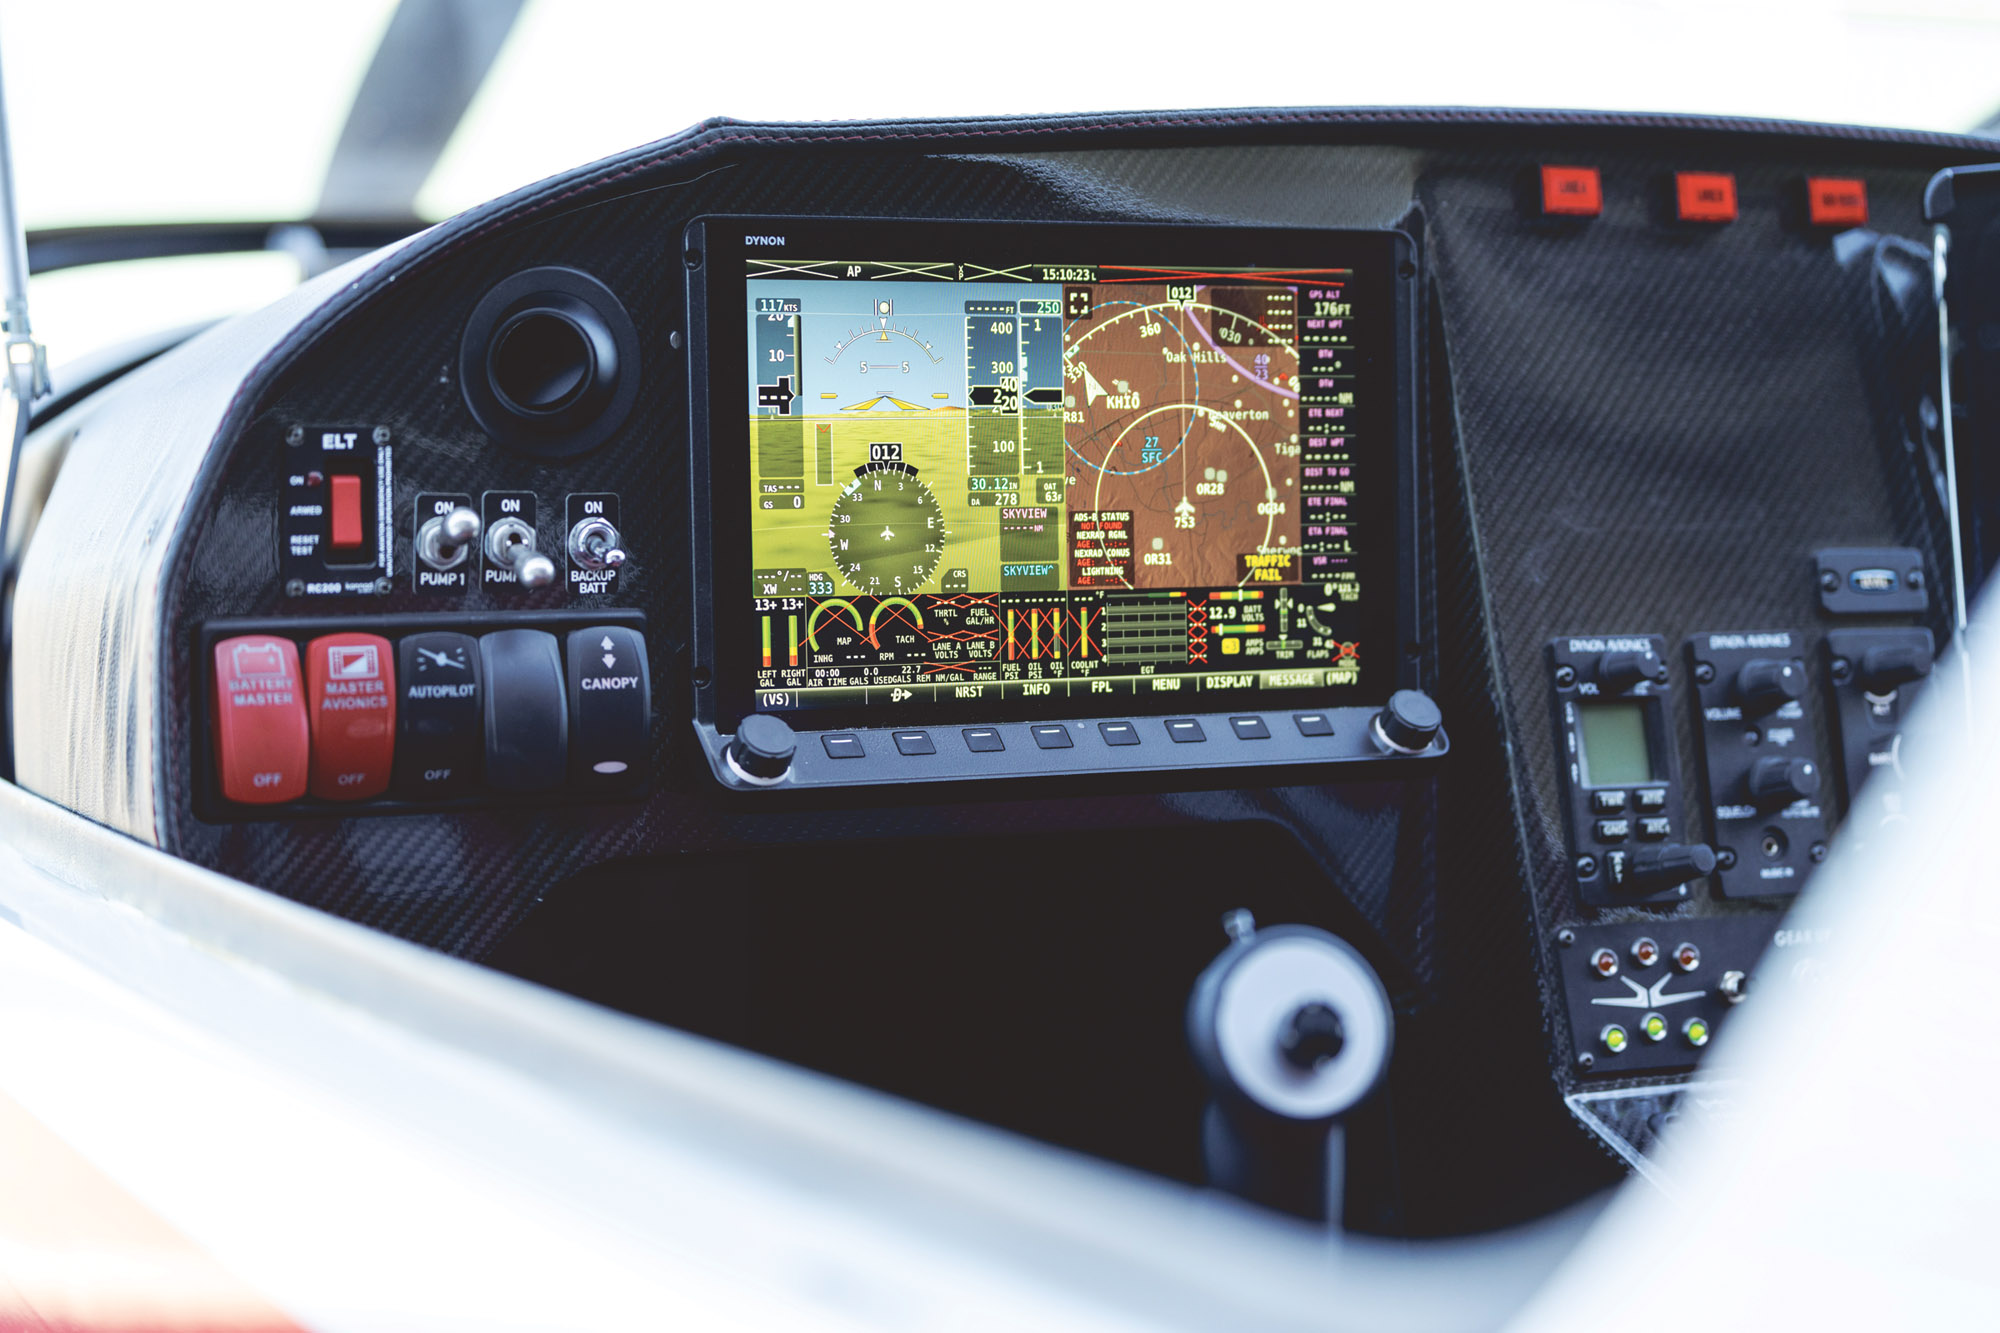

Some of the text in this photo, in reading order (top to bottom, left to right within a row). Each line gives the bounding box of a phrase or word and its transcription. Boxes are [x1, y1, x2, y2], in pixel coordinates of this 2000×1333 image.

[745, 235, 785, 246] DYNON
[846, 266, 862, 278] AP
[1042, 268, 1090, 281] 15:10:23
[1171, 287, 1192, 298] 012
[1037, 302, 1059, 314] 250
[990, 322, 1012, 334] 400
[1034, 319, 1042, 332] 1
[1139, 322, 1161, 338] 360
[769, 350, 784, 362] 10
[1166, 352, 1228, 363] Oak Hills
[860, 361, 910, 374] 5 5
[991, 361, 1014, 374] 300
[1255, 369, 1268, 380] 23
[1002, 378, 1018, 392] 40
[1002, 396, 1018, 410] 20
[322, 434, 357, 450] ELT
[992, 440, 1014, 452] 100
[1145, 436, 1159, 448] 27
[872, 445, 900, 460] 012
[1142, 452, 1162, 463] SFC
[1036, 461, 1044, 473] 1
[290, 475, 304, 486] ON
[874, 480, 904, 491] N 3
[794, 496, 801, 508] 0
[852, 493, 923, 504] 33 6
[971, 494, 1018, 506] DA 278
[290, 505, 322, 516] ARMED
[434, 501, 454, 514] ON
[501, 499, 520, 512] ON
[584, 501, 603, 514] ON
[1002, 508, 1048, 519] SKYVIEW
[1074, 512, 1130, 522] ADS-B STATUS
[840, 515, 934, 528] 30 E
[1081, 522, 1122, 530] NOT FOUND
[1174, 516, 1196, 528] 753
[290, 534, 320, 545] RESET
[1076, 530, 1128, 540] NEXRAD RGNL
[840, 539, 935, 552] W 12
[1077, 540, 1095, 549] AGE:
[290, 546, 314, 556] TEST
[1074, 548, 1130, 558] NEXRAD CONUS
[1077, 558, 1095, 566] AGE:
[1244, 554, 1292, 568] TRAFFIC
[850, 563, 924, 574] 24 15
[952, 570, 966, 578] CRS
[1082, 566, 1124, 576] LIGHTNING
[420, 572, 464, 586] PUMP 1
[485, 570, 516, 582] PUM
[571, 570, 616, 582] BACKUP
[1078, 576, 1096, 584] AGE:
[1254, 568, 1282, 582] FAIL
[306, 582, 342, 594] RC200
[580, 582, 608, 594] BATT
[870, 576, 902, 588] 21 S
[764, 584, 778, 594] XW
[808, 582, 833, 595] 333
[755, 598, 804, 610] 13+ 13+
[934, 608, 990, 618] THRTL FUEL
[1209, 604, 1262, 620] 12.9 BATT
[1242, 613, 1264, 622] VOLTS
[966, 616, 994, 625] GAL/HR
[837, 636, 914, 645] MAP TACH
[932, 640, 995, 650] LANE A LANE B
[1246, 638, 1264, 647] AMPS
[935, 650, 992, 658] VOLTS VOLTS
[1246, 647, 1264, 656] AMPS
[1276, 650, 1330, 659] TRIM FLAPS
[814, 652, 894, 664] INHG RPM
[815, 666, 921, 678] 00:00 0.0 22.7
[1002, 660, 1098, 672] FUEL OIL OIL COOLNT
[1140, 666, 1155, 674] EGT
[758, 669, 806, 678] LEFT RIGHT
[892, 674, 930, 684] GALS REM
[936, 672, 997, 682] NM/GAL RANGE
[1004, 671, 1042, 680] PSI PSI
[230, 678, 293, 691] BATTERY
[582, 676, 638, 690] CANOPY
[760, 678, 802, 688] GAL GAL
[808, 678, 848, 687] AIR TIME
[850, 676, 893, 685] GALS USED
[956, 672, 1358, 698] NRST INFO FPL MENU DISPLAY MESSAGE (MAP)
[326, 680, 384, 694] MASTER
[408, 684, 475, 698] AUTOPILOT
[234, 692, 292, 706] MASTER
[322, 696, 388, 711] AVIONICS
[762, 692, 790, 707] (VS)
[254, 772, 282, 787] OFF
[337, 772, 365, 786] OFF
[424, 769, 451, 780] OFF
